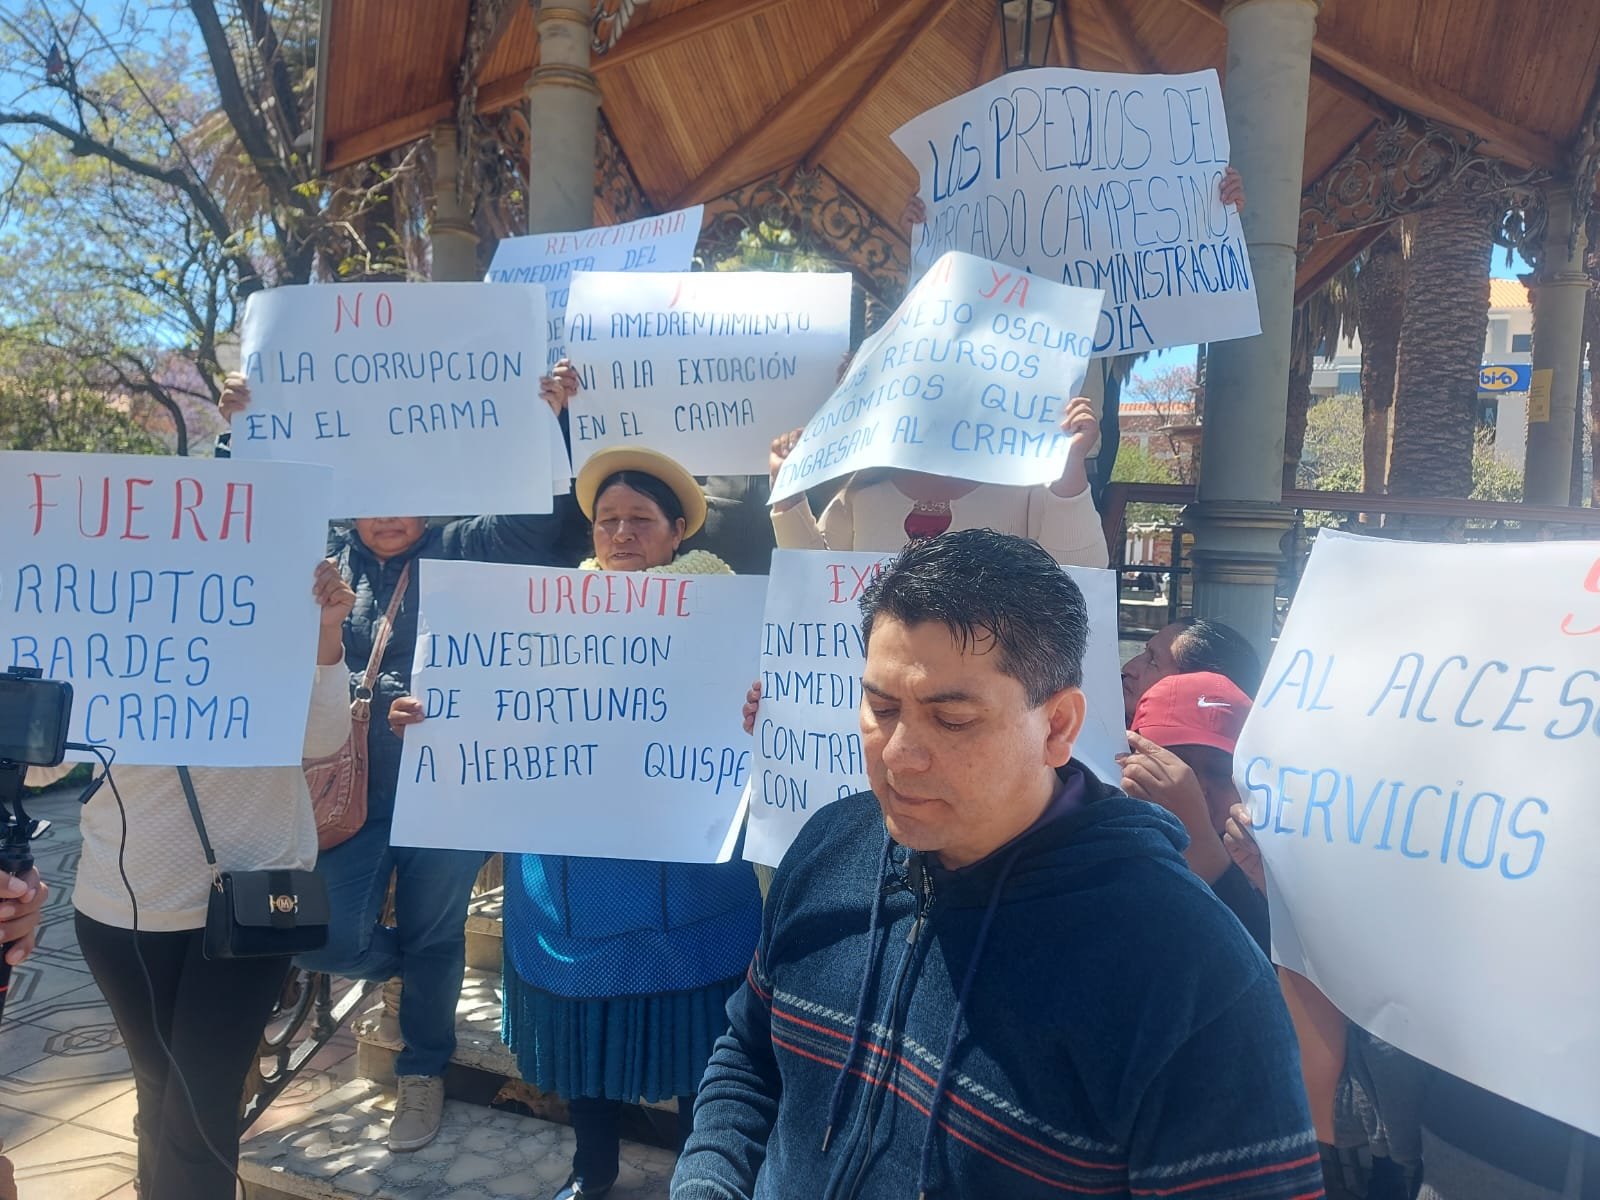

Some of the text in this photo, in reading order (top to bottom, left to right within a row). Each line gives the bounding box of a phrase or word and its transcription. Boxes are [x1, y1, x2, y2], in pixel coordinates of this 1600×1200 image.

[928, 86, 1228, 203] LOS PREDIOS DEL
[545, 211, 687, 257] REVOCATORIA
[619, 244, 657, 272] DEL
[978, 265, 1030, 309] YA
[334, 292, 392, 334] NO
[570, 312, 598, 343] AL
[992, 313, 1095, 358] OSCURO
[246, 350, 522, 385] A LA CORRUPCION
[612, 360, 625, 390] A
[633, 359, 654, 389] LA
[881, 338, 1041, 379] RECURSOS
[246, 399, 499, 441] EN EL CRAMA
[576, 414, 607, 441] EN
[620, 411, 644, 437] EL
[981, 384, 1062, 424] QUE
[778, 421, 880, 490] INGRESAN
[892, 415, 924, 444] AL
[27, 472, 254, 544] FUERA
[14, 564, 256, 627] RRUPTOS
[528, 574, 694, 618] URGENTE
[825, 563, 881, 605] EX
[11, 633, 210, 687] BARDES
[424, 686, 668, 723] DE FORTUNAS
[761, 670, 864, 710] INMEDI
[1262, 648, 1600, 740] AL ACCES
[85, 693, 249, 744] CRAMA
[415, 740, 751, 796] A HERBERT QUISPE
[761, 718, 863, 775] CONTRA
[763, 769, 808, 813] CON
